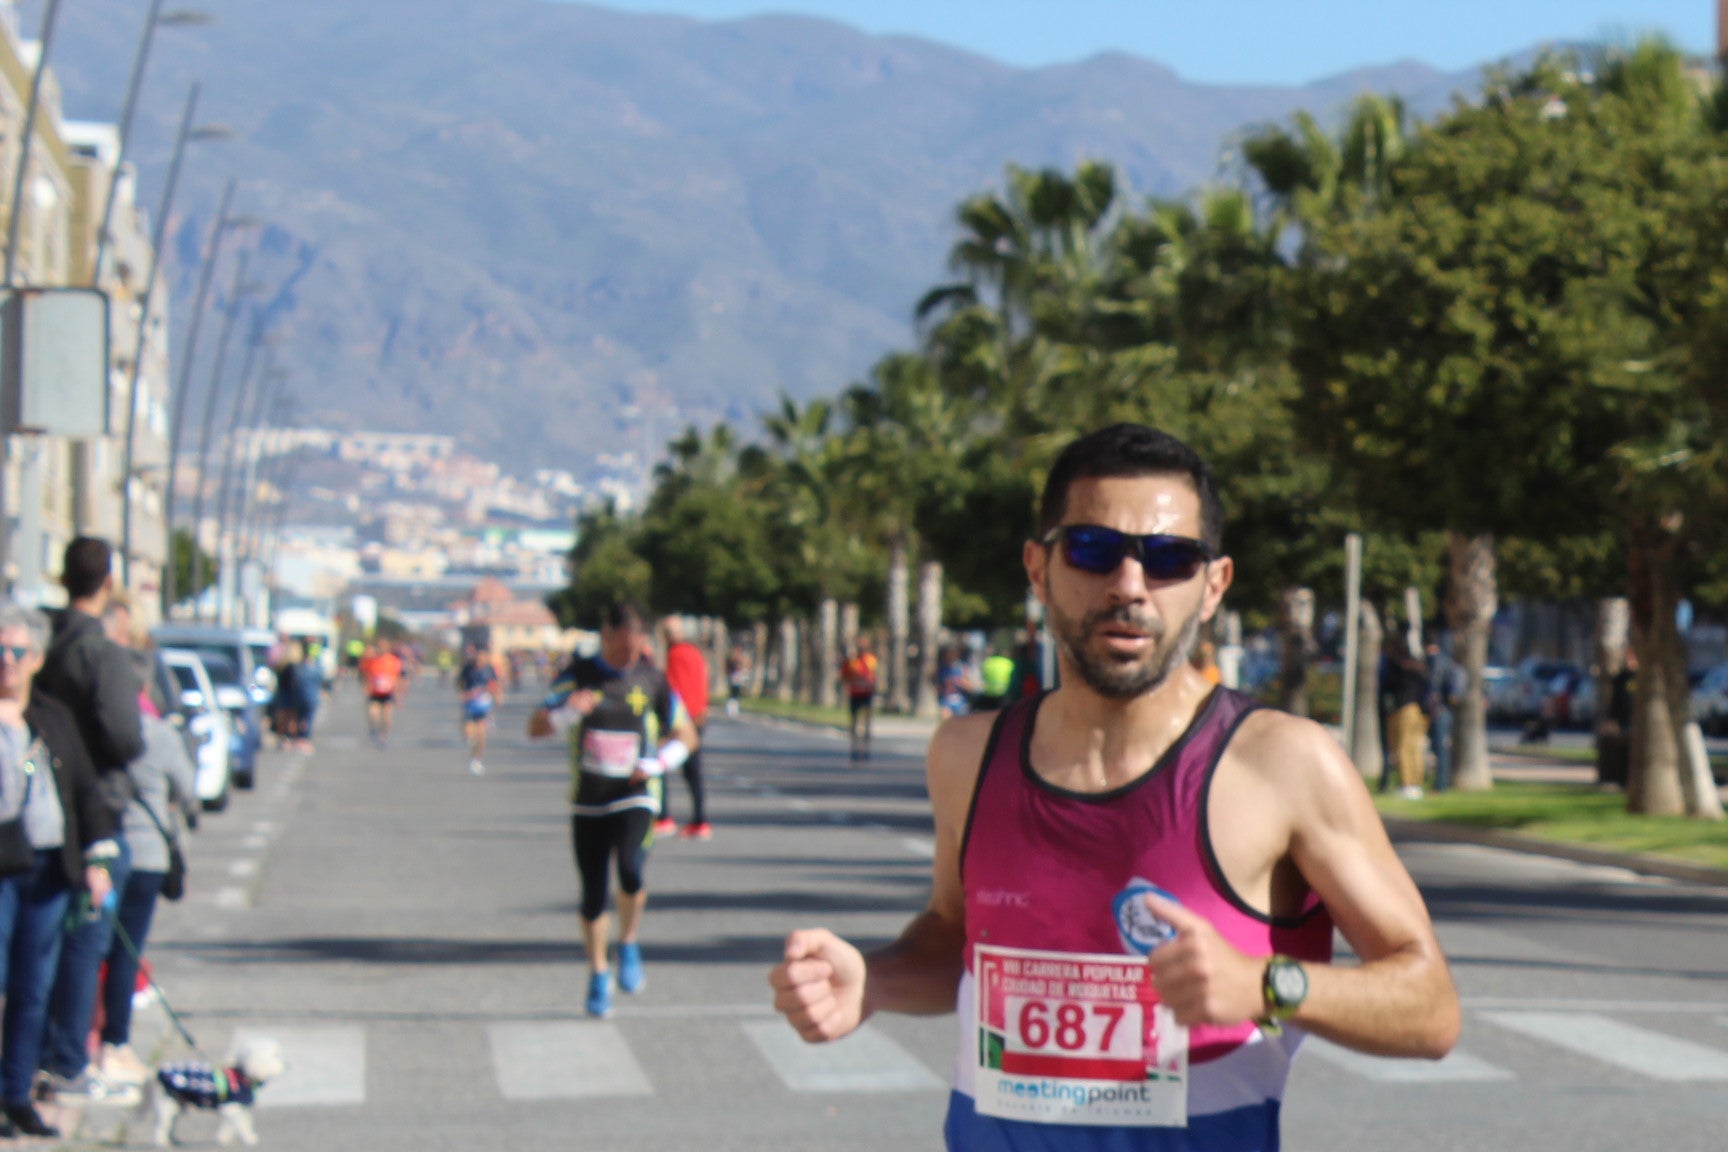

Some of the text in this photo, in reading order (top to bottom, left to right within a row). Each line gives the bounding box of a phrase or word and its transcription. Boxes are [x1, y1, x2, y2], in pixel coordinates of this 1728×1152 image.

[1024, 960, 1081, 980] CARRERA
[1082, 965, 1144, 983] POPULAR
[1003, 976, 1137, 1000] CIUDAD DE ROQUETAS
[1019, 999, 1125, 1052] 687
[997, 1078, 1151, 1105] meetingpoint
